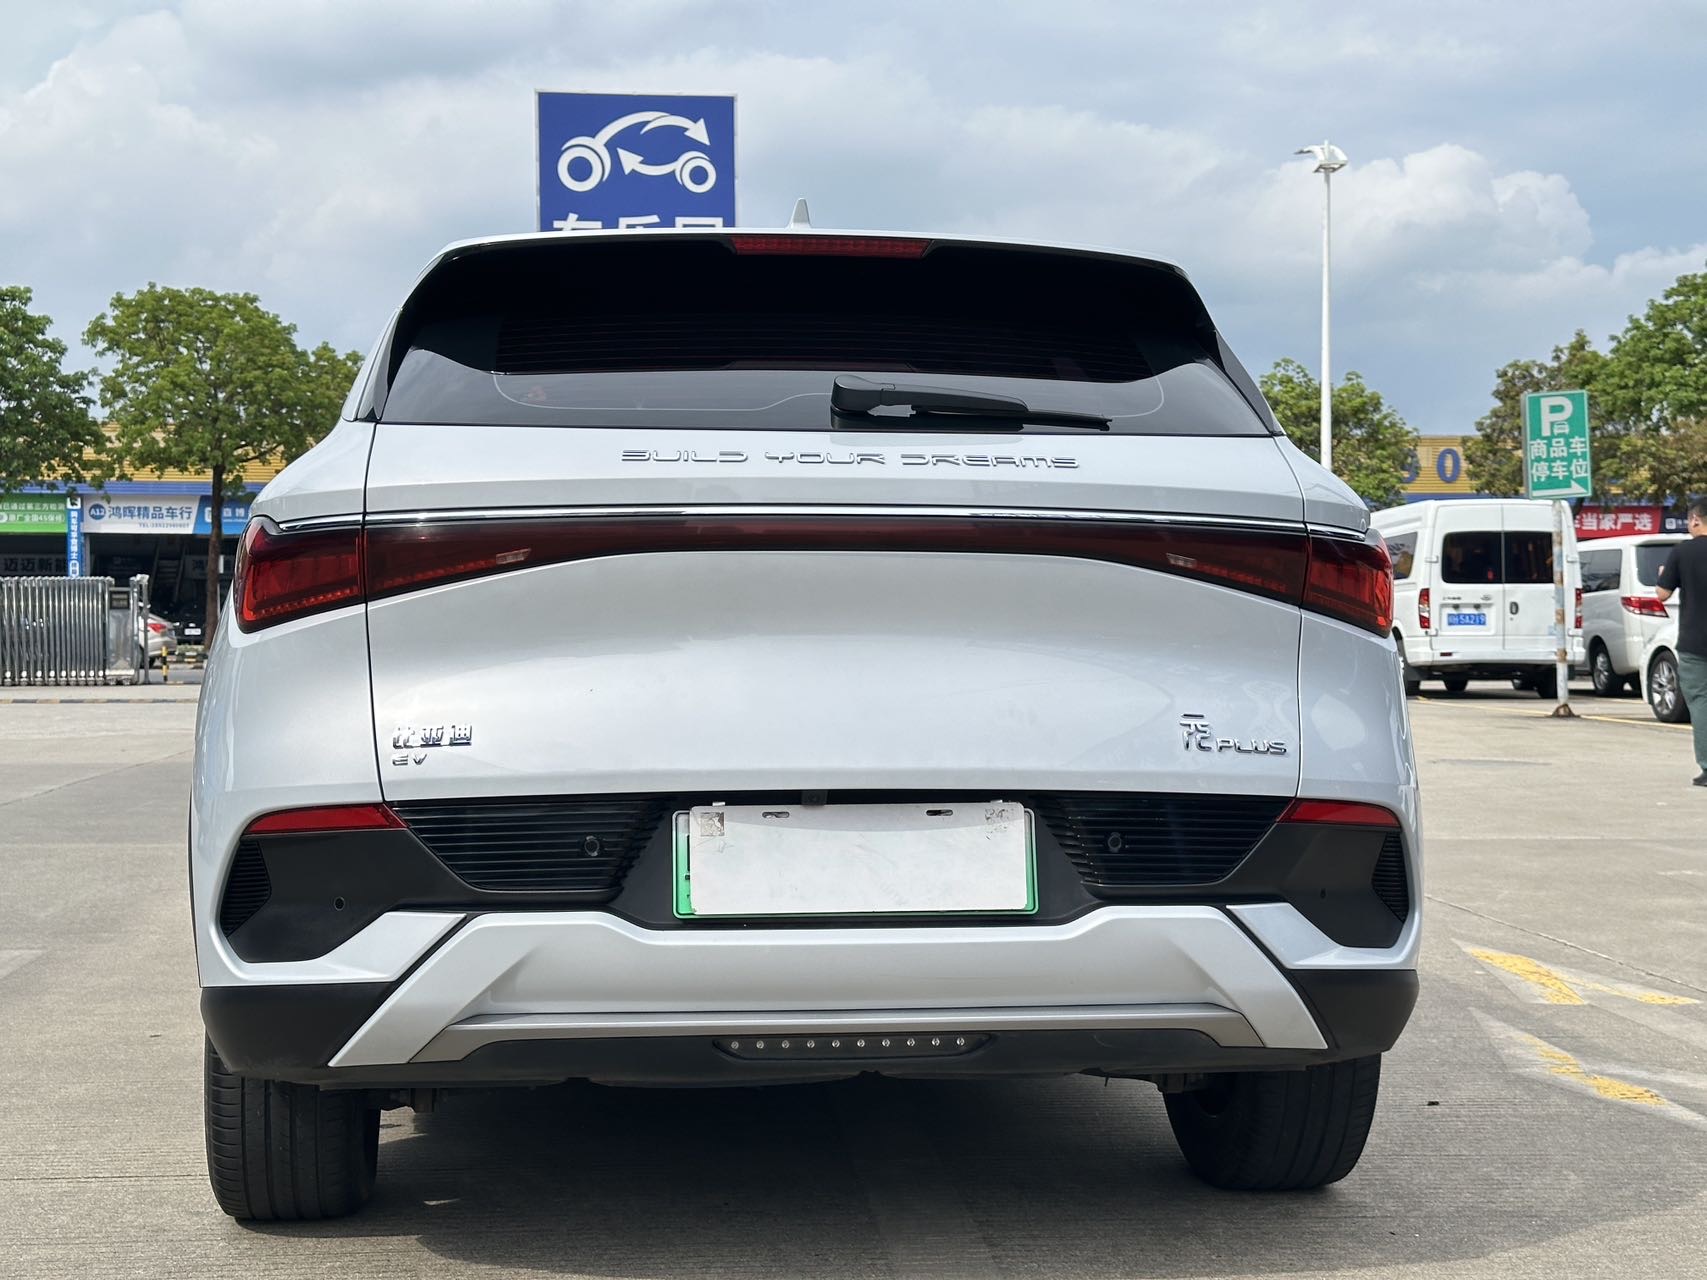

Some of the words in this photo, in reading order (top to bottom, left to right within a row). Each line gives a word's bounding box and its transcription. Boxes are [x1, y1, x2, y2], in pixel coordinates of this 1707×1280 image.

[1541, 396, 1573, 436] P
[1529, 436, 1588, 460] 商品车
[620, 449, 749, 465] BUILD
[764, 450, 886, 466] YOUR
[899, 452, 1080, 469] DREAMS
[1531, 458, 1590, 482] 停车位
[107, 505, 193, 520] 鸿晖精品车行
[1216, 738, 1287, 755] PLUS
[392, 753, 428, 767] EV
